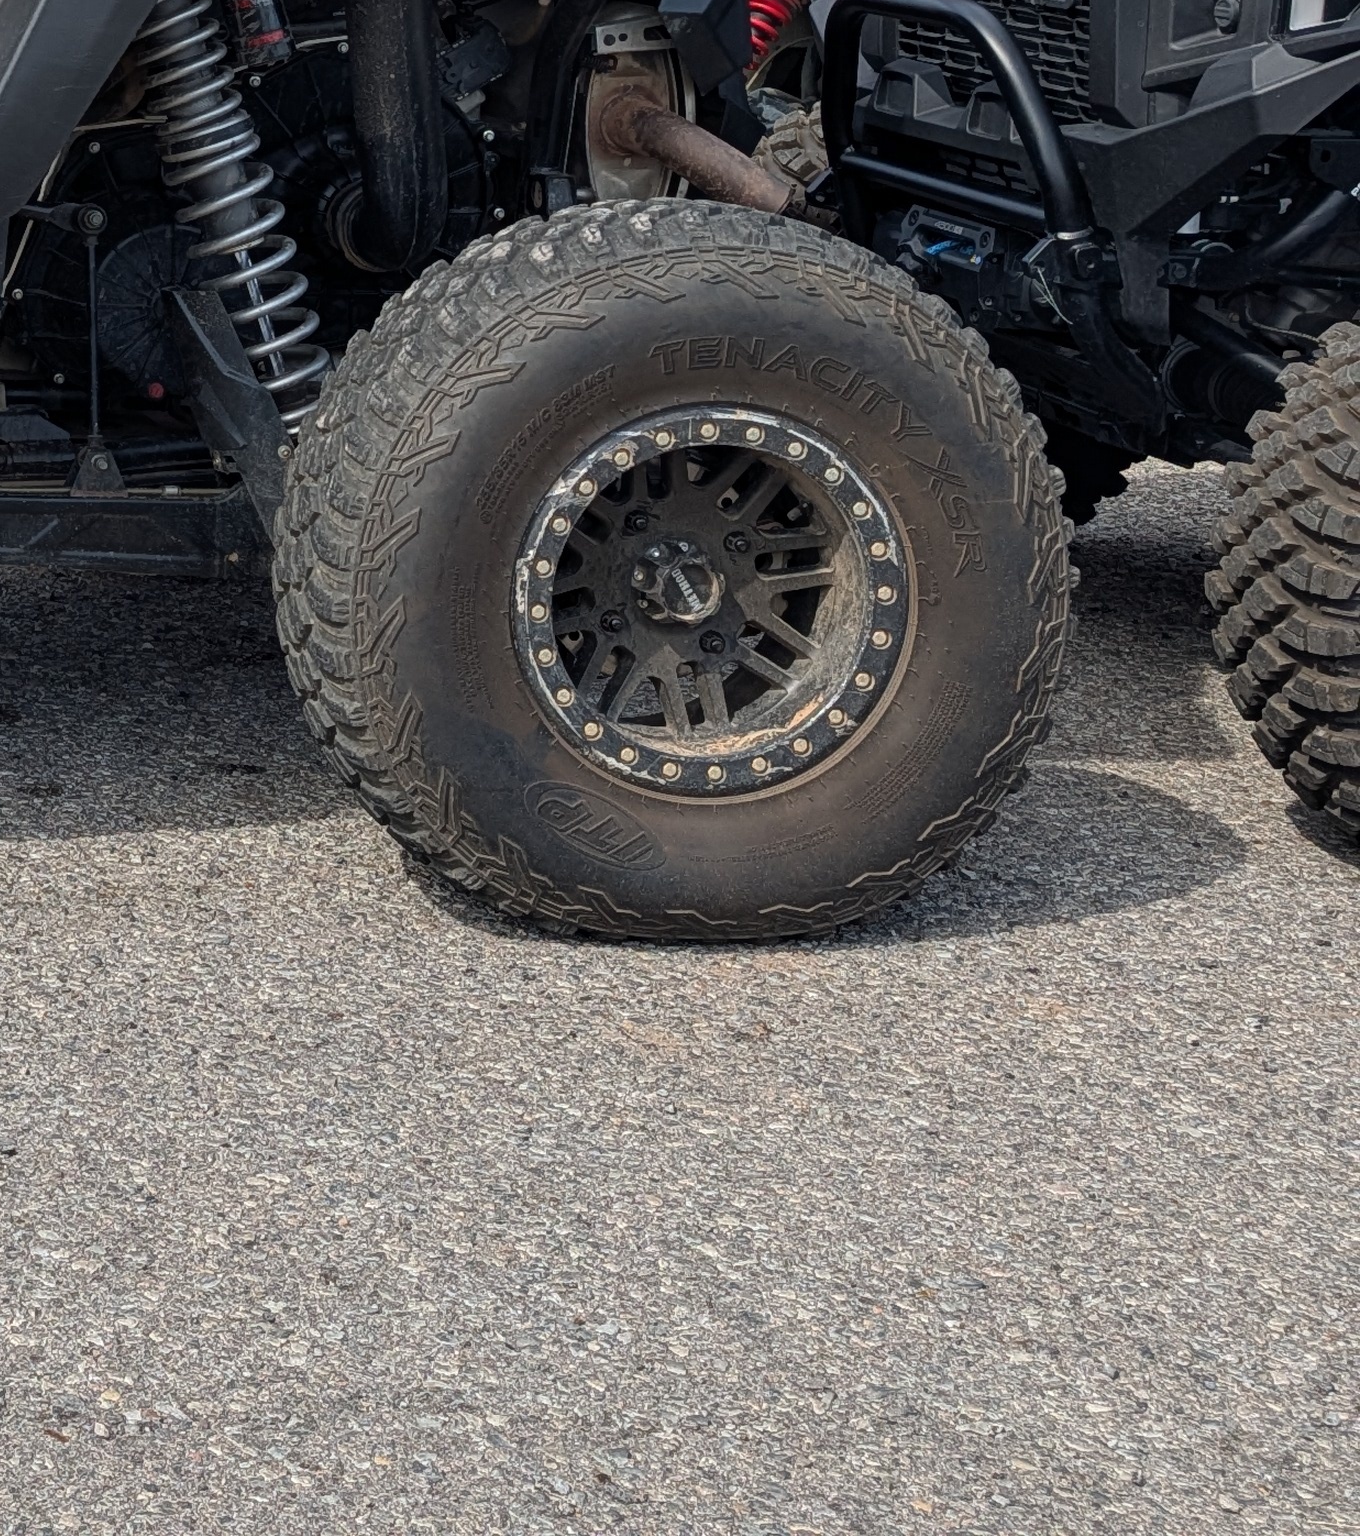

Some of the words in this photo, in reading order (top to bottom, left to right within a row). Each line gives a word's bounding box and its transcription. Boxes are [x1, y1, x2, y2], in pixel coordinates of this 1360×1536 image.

[648, 335, 932, 442] TENACITY
[892, 446, 986, 579] XSR
[671, 568, 705, 614] METHOD
[536, 796, 654, 864] ITP
